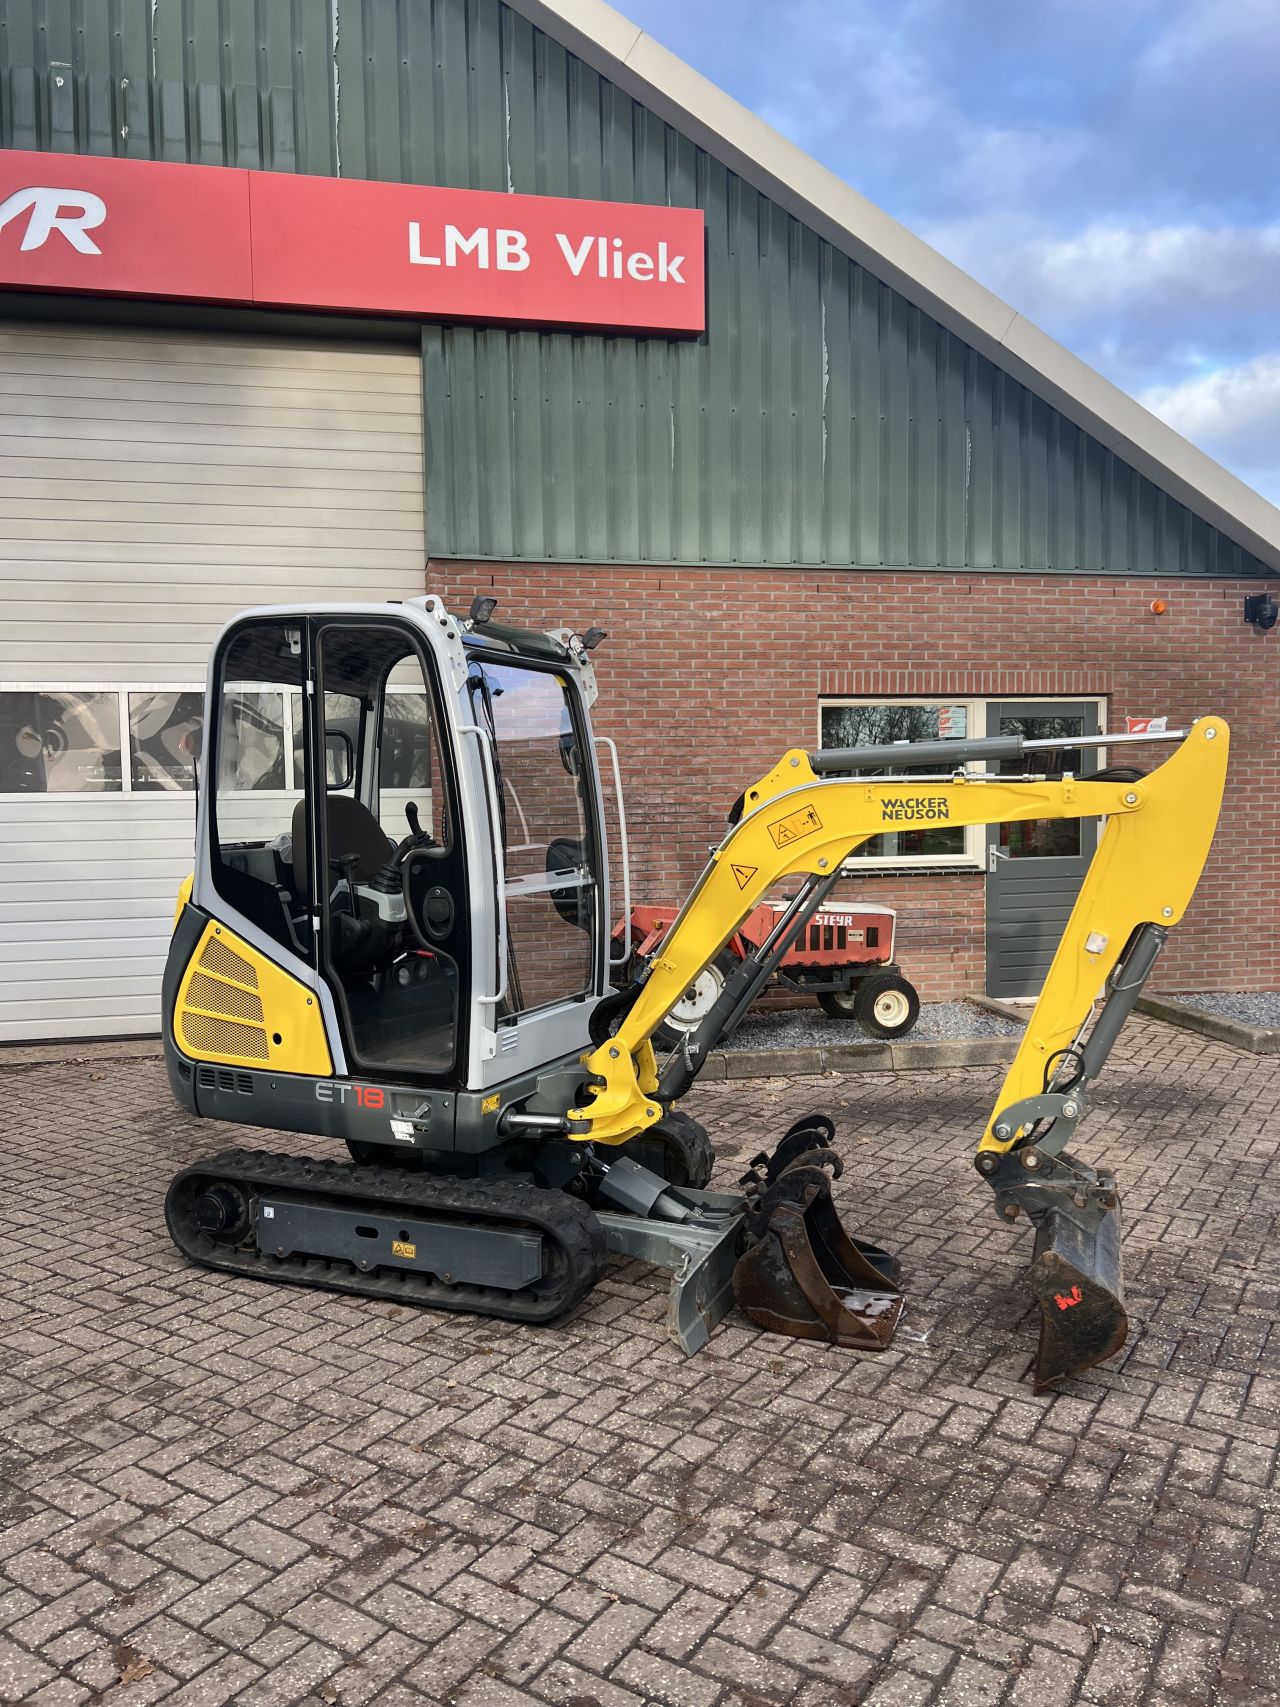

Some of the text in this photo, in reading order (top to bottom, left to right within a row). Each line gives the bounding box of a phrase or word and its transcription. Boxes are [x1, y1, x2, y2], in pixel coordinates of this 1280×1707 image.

[408, 221, 686, 284] LMB Vliek
[881, 797, 949, 809] WACKER
[882, 808, 949, 820] NEUSON
[815, 914, 853, 927] STEYR
[315, 1081, 385, 1109] ET18
